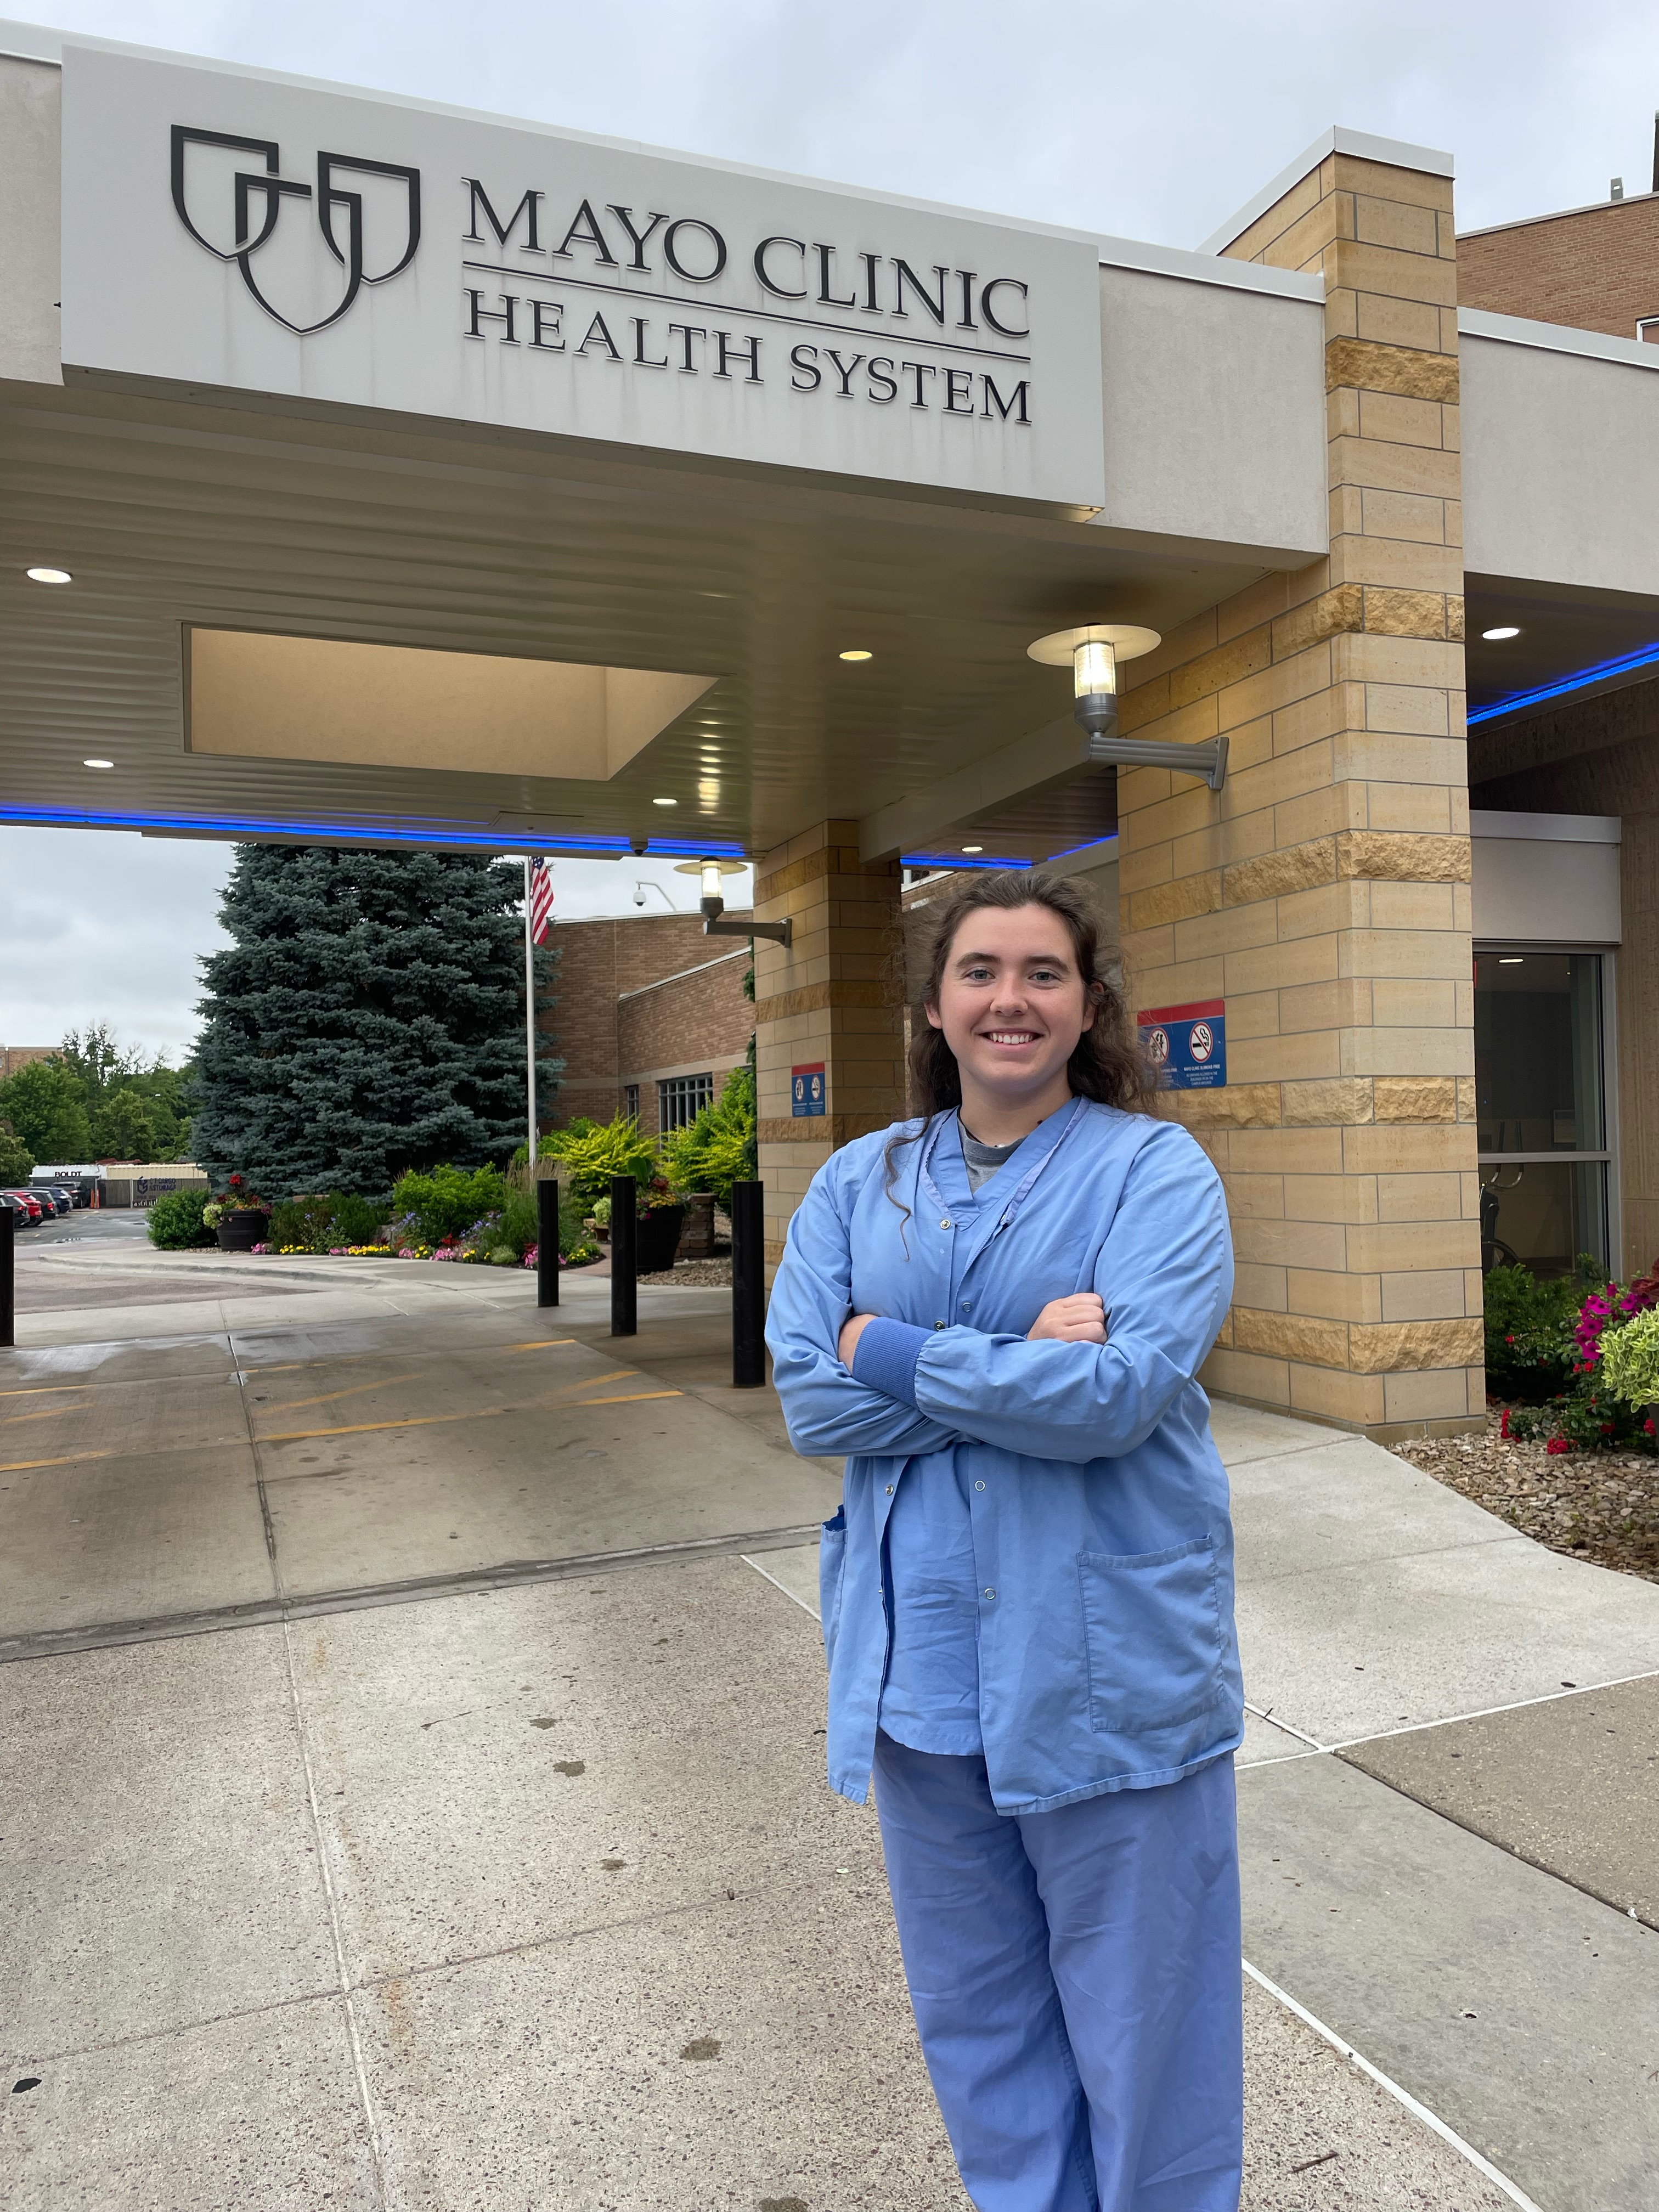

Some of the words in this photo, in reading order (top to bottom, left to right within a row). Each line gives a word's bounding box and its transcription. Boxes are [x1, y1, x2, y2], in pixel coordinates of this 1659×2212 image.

[461, 177, 727, 283] MAYO
[753, 236, 1030, 337] CLINIC
[463, 288, 764, 383] HEALTH
[790, 344, 1032, 424] SYSTEM
